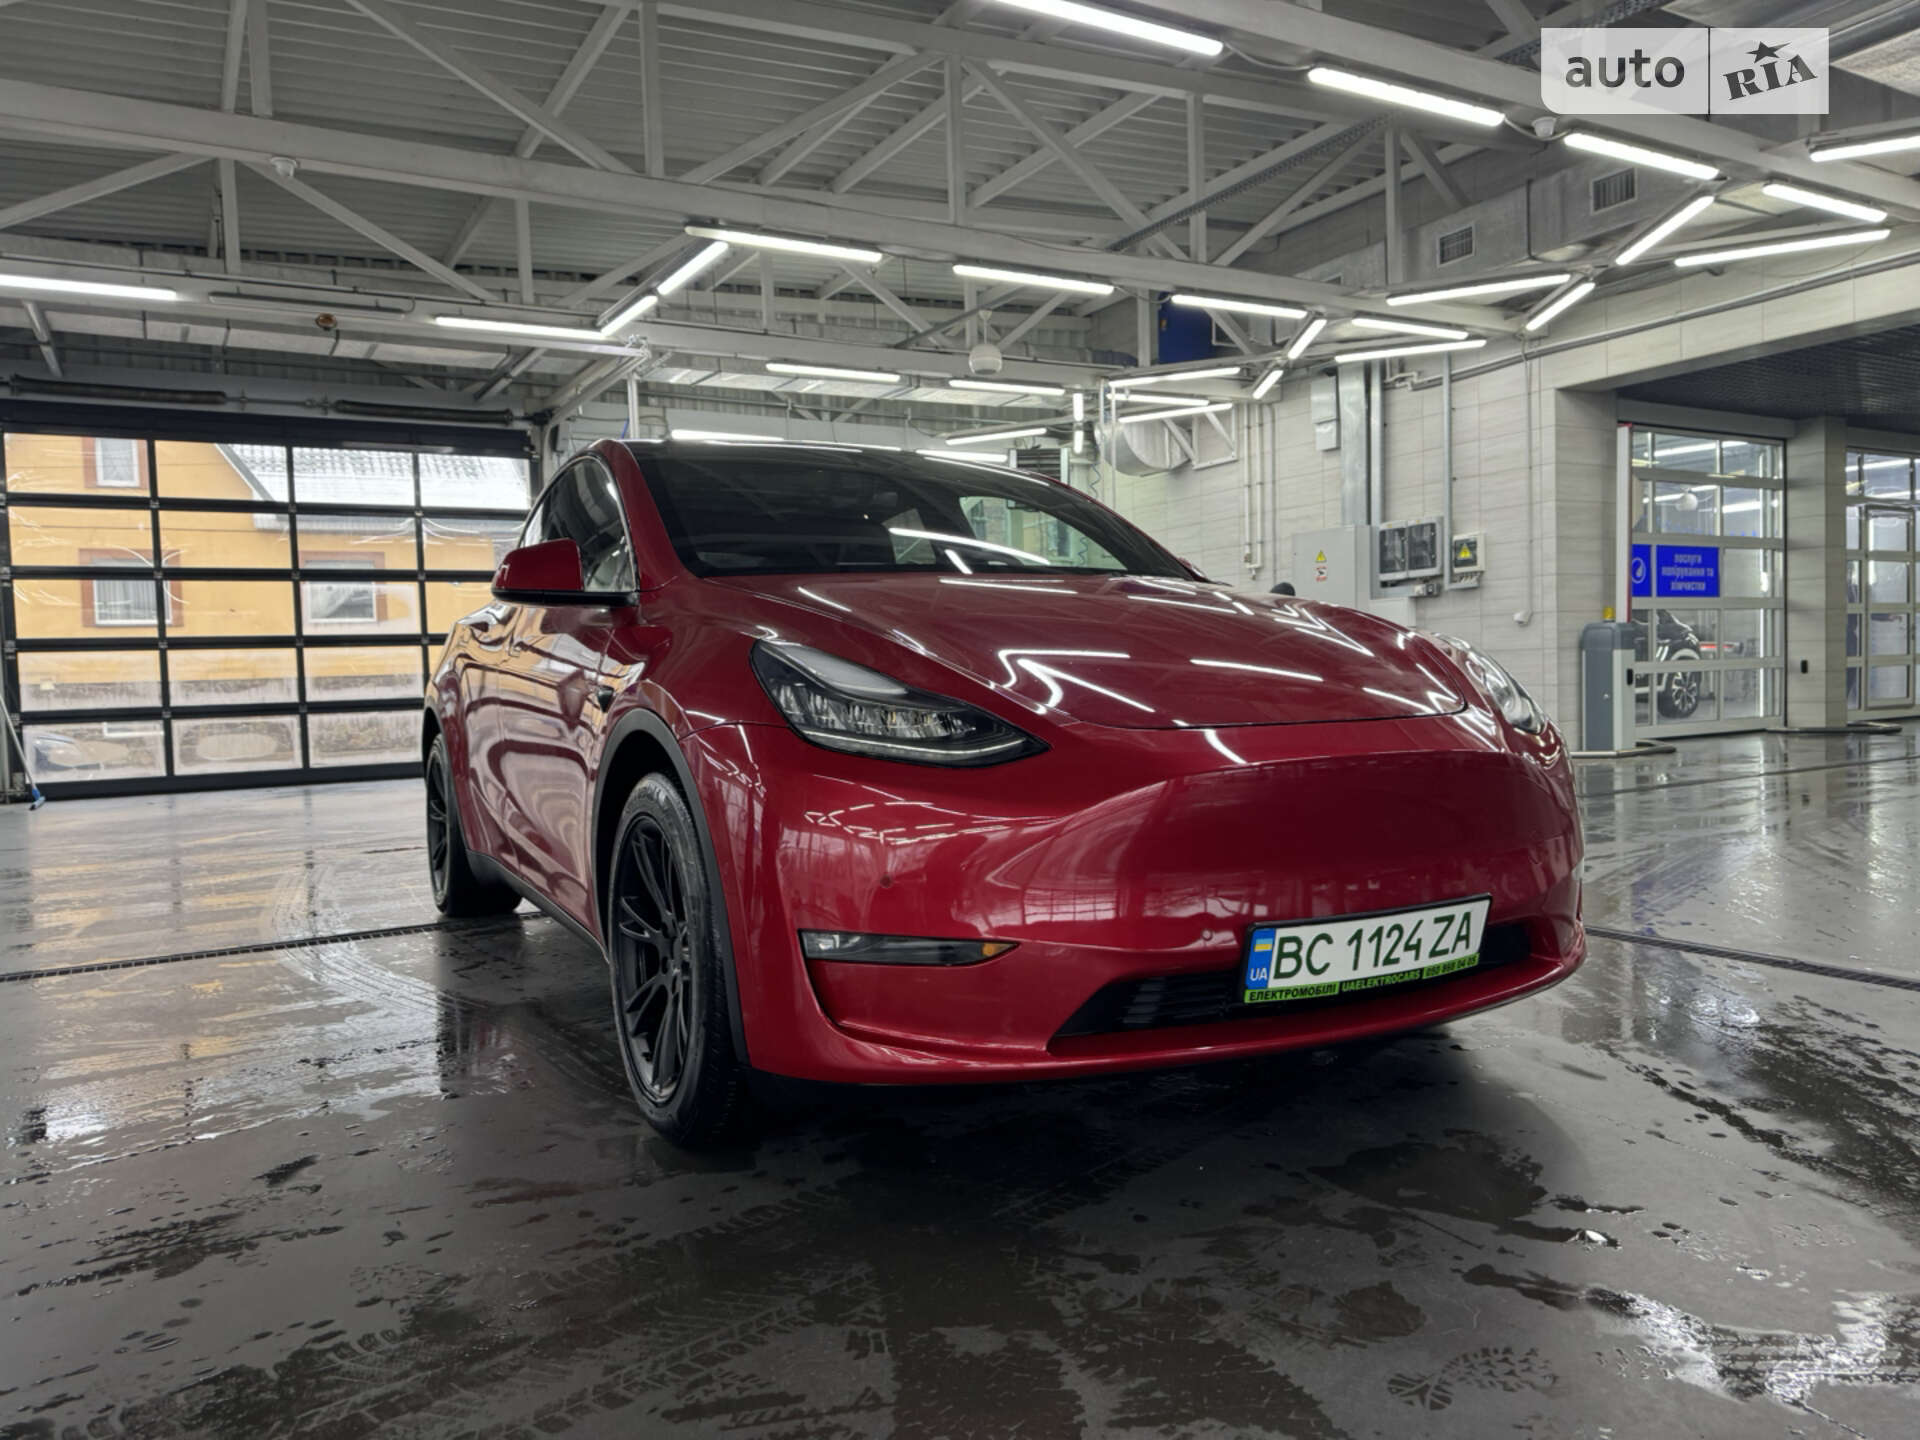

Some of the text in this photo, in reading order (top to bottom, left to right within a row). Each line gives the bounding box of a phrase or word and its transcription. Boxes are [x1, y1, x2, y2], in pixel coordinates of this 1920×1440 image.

[1674, 554, 1702, 566] послуги
[1273, 911, 1471, 980] BC 1124 ZA
[1249, 967, 1268, 982] UA
